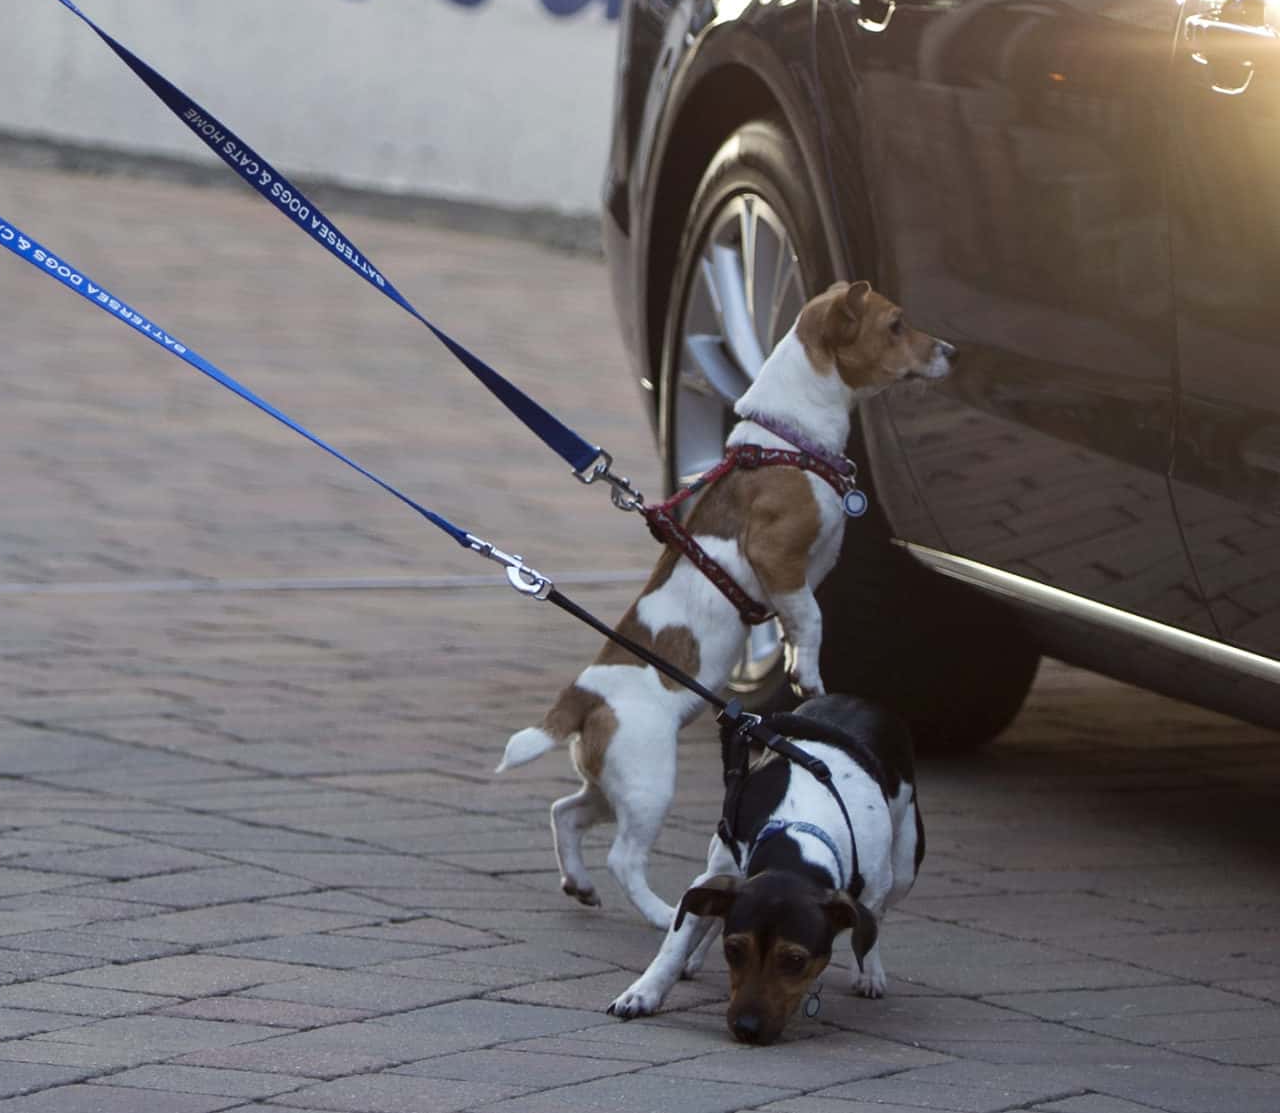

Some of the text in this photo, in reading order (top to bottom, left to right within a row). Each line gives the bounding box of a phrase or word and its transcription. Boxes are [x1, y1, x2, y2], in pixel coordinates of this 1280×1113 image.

[183, 107, 385, 287] BATTERSEA DOGS & CATS HOME
[17, 236, 32, 251] &
[32, 249, 83, 286] DOGS
[86, 283, 187, 354] BATTERSEA
